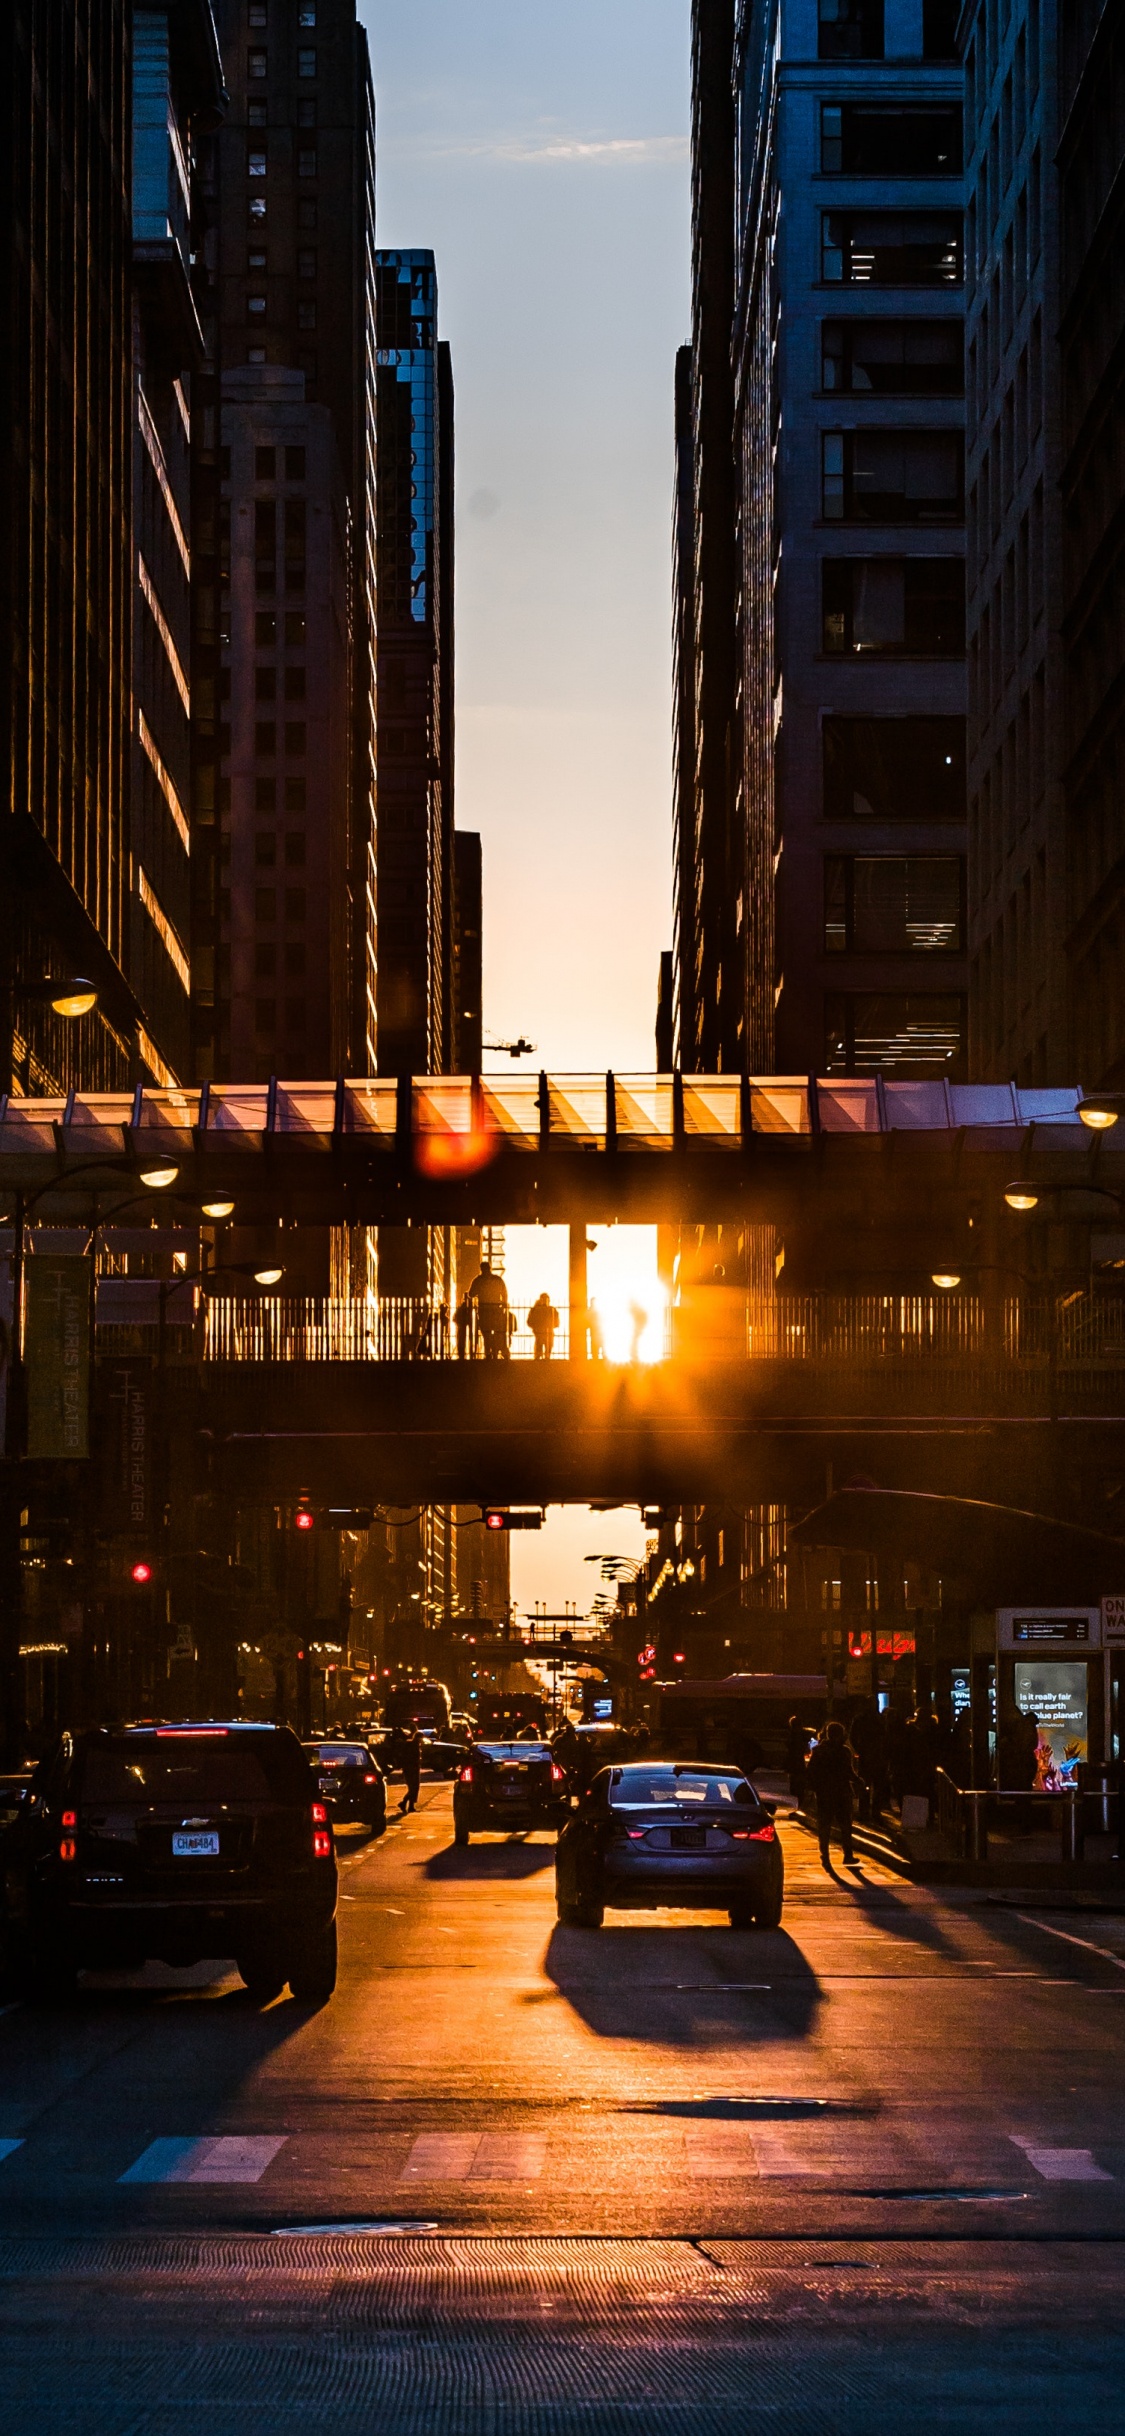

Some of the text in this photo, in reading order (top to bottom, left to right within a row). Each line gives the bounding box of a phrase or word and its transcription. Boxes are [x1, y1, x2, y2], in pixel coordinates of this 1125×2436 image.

[63, 1295, 80, 1447] HARRIS THEATER
[131, 1391, 145, 1521] HARRIS THEATER
[1035, 1693, 1057, 1702] really
[1029, 1702, 1044, 1710] call
[1044, 1702, 1066, 1710] earth
[1052, 1711, 1083, 1720] planet?
